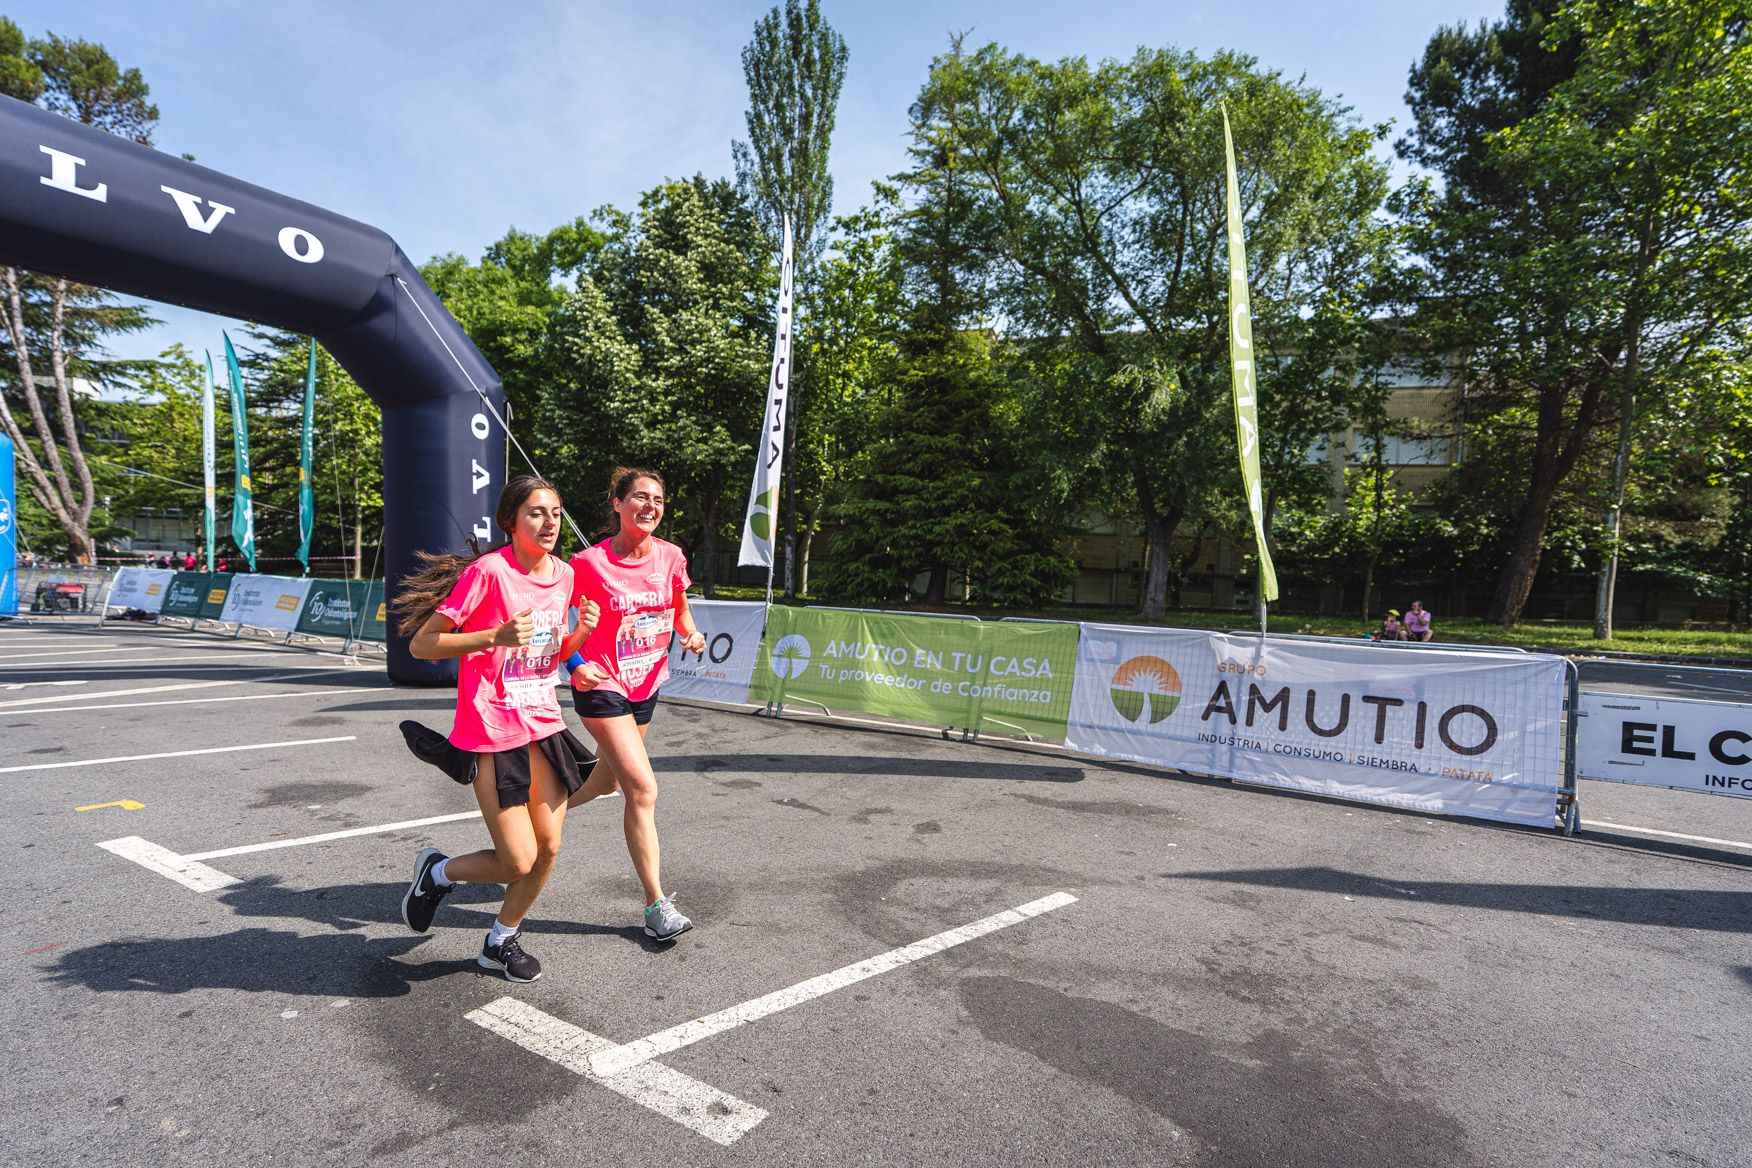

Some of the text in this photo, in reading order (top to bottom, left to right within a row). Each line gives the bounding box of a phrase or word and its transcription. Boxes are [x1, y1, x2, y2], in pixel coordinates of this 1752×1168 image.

[635, 635, 656, 647] 016
[526, 656, 551, 668] 016
[823, 640, 1053, 678] AMUTIO EN TU CASA
[1217, 662, 1267, 676] GRUPO
[671, 669, 696, 677] SIEMBRA
[819, 664, 1052, 703] Tu proveedor de Confianza
[1201, 679, 1498, 756] AMUTIO
[1198, 732, 1493, 782] INDUSTRIA CONSUMO SIEMBRA PATATA
[1621, 721, 1752, 766] EL C
[1705, 774, 1752, 791] INFO
